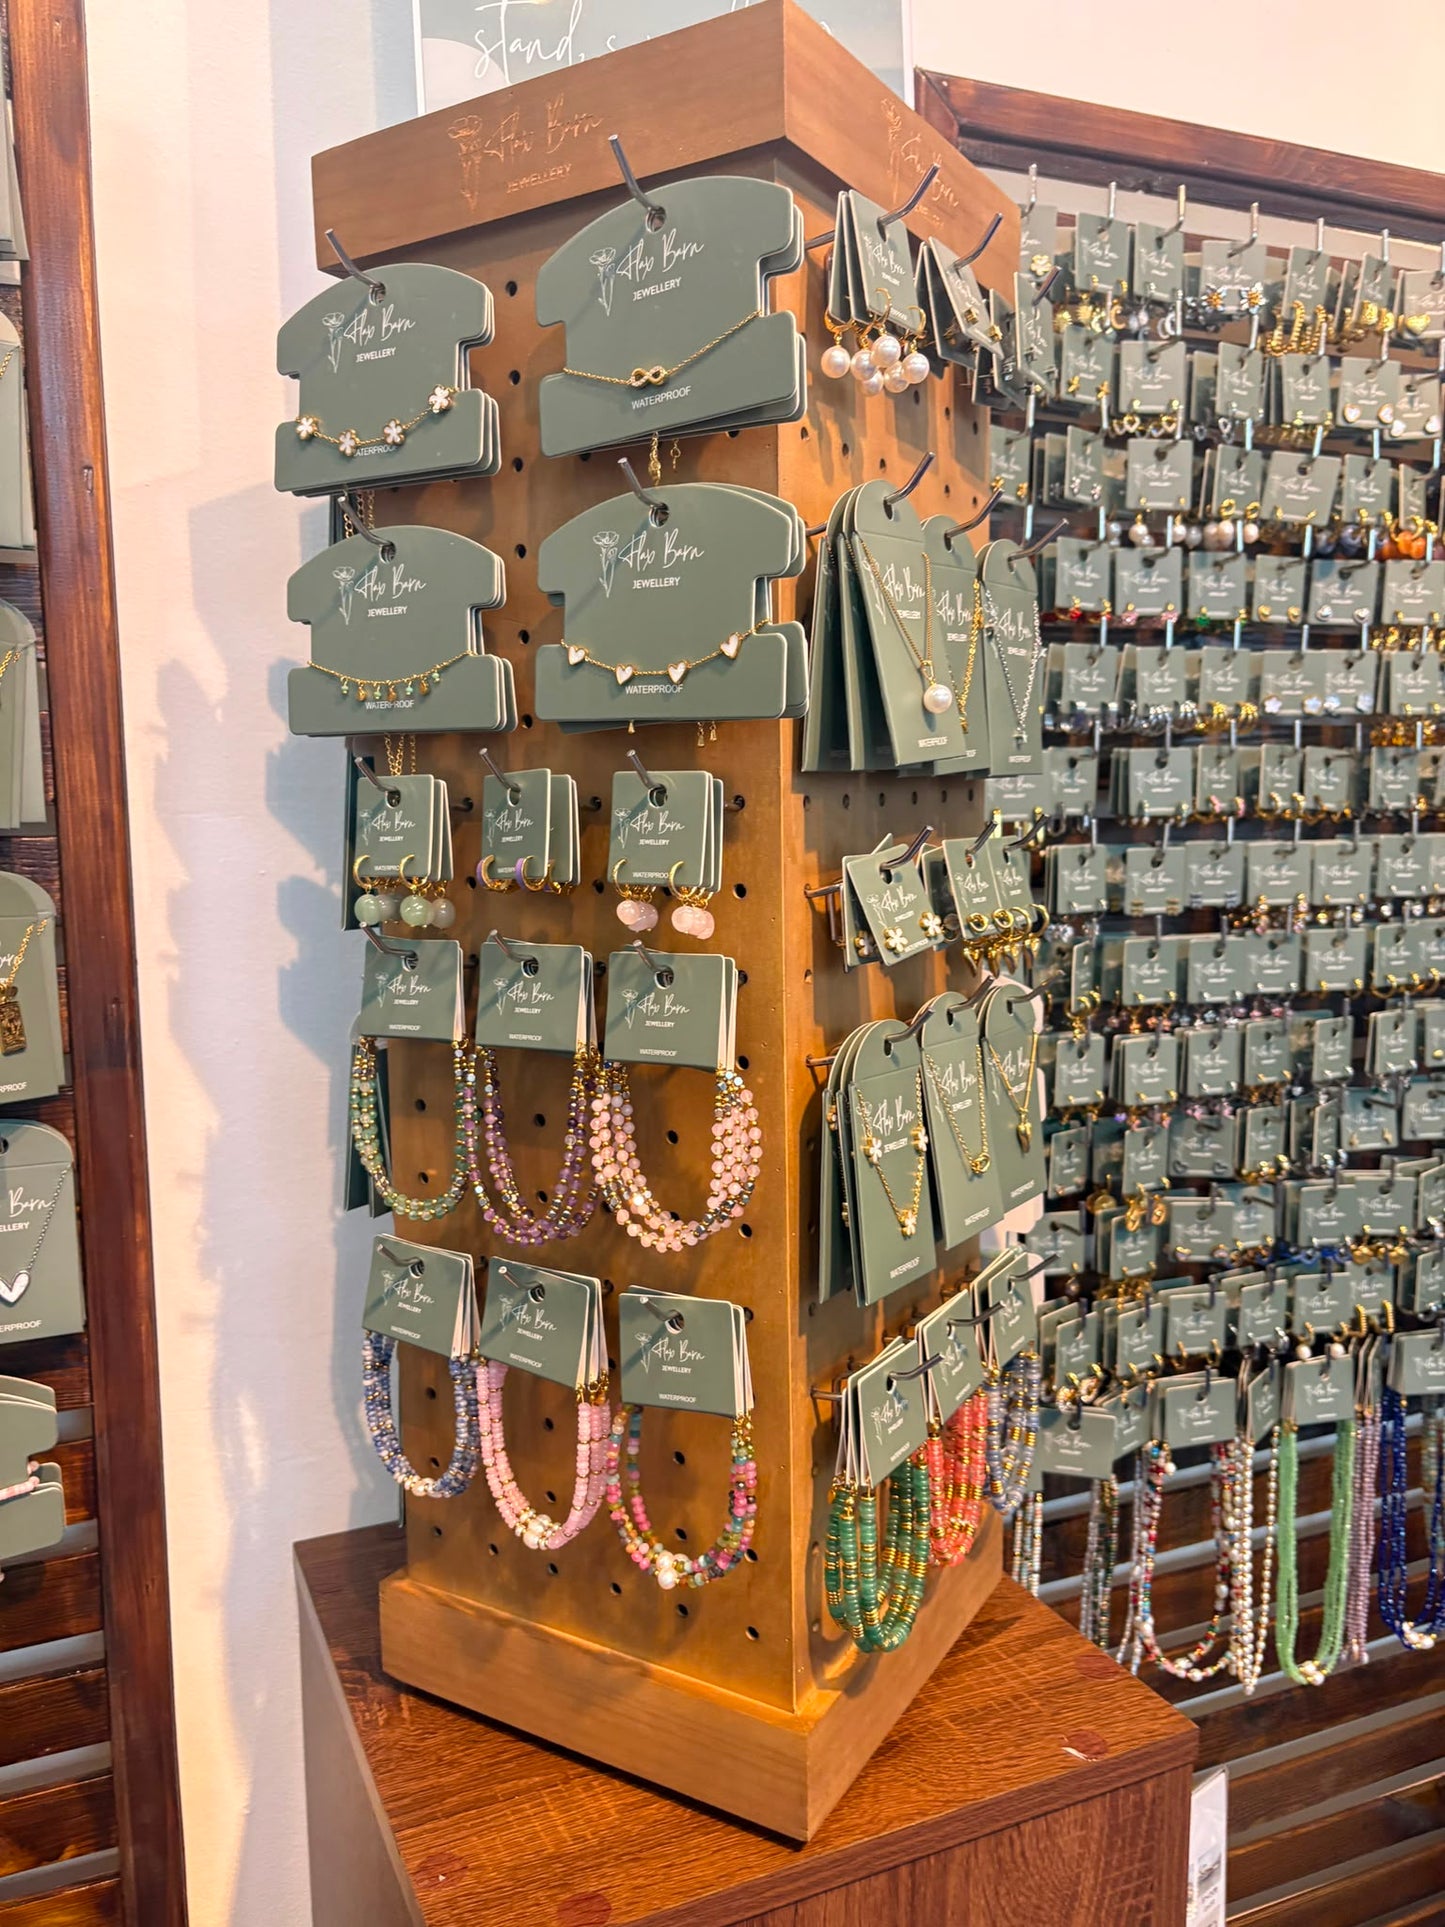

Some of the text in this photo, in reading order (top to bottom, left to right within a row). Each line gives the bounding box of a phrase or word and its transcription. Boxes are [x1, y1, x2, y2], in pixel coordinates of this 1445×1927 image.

[632, 277, 682, 301] JEWELLERY
[355, 347, 397, 363] JEWELLERY
[631, 385, 692, 409] WATERPROOF
[354, 445, 398, 457] ATERPROO
[632, 576, 681, 589] JEWELLERY
[367, 605, 408, 617] JEWELLERY
[625, 684, 684, 694] WATERPROOF
[9, 1186, 55, 1217] Barn
